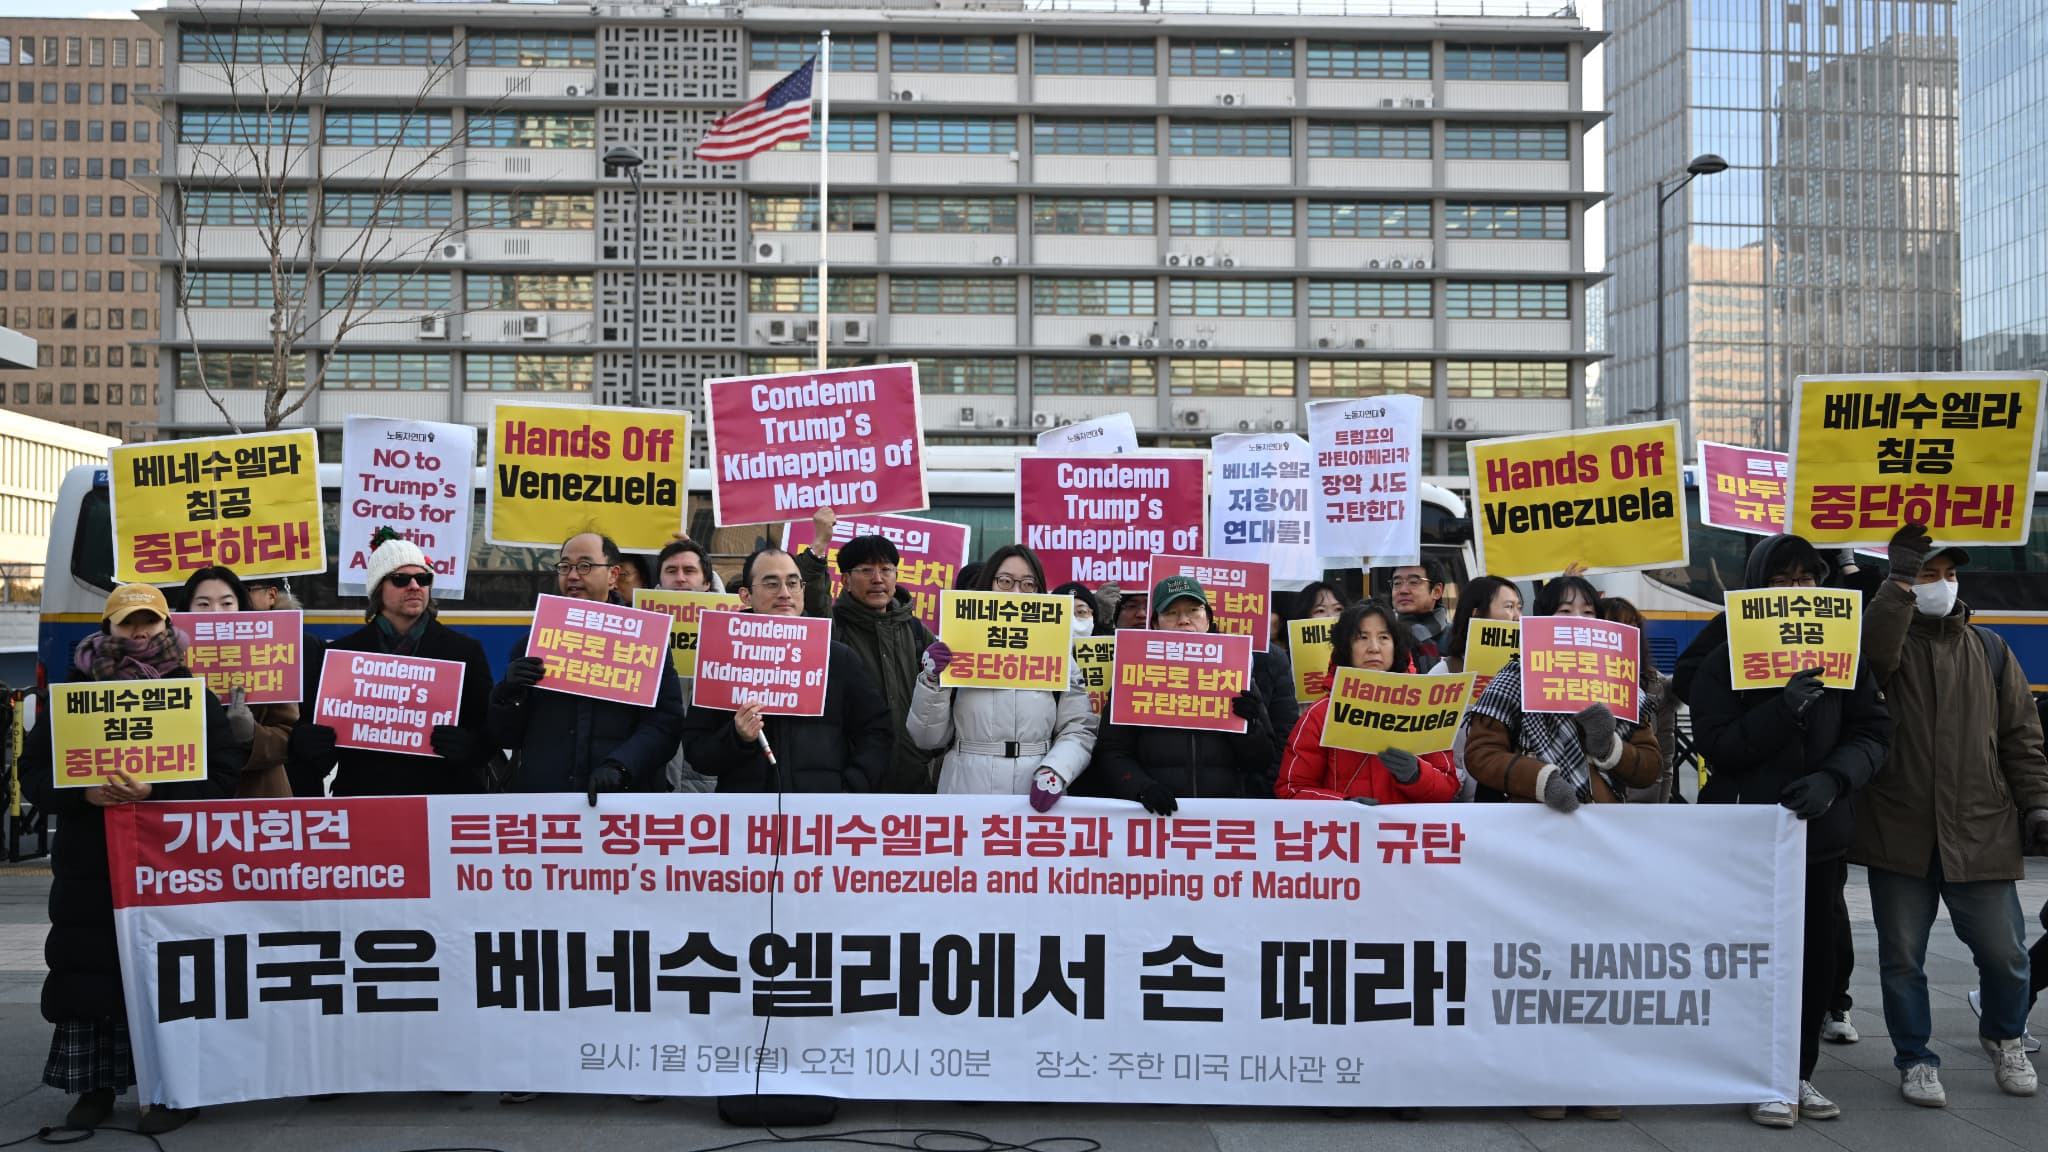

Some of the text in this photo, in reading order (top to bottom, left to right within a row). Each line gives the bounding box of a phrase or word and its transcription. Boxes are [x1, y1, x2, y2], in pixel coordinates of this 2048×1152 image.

[751, 378, 876, 412] Condemn
[1824, 391, 2022, 430] 베네수엘라
[504, 420, 675, 463] Hands Off
[761, 410, 871, 444] Trump's
[1335, 427, 1394, 446] 트럼프의
[133, 444, 301, 487] 베네수엘라
[373, 448, 441, 471] NO to
[724, 438, 913, 482] Kidnapping of
[1318, 447, 1410, 468] 라틴아메리카
[1486, 441, 1665, 493] Hands Off
[1876, 437, 1955, 476] 침공
[359, 473, 457, 501] Trump's
[498, 464, 677, 507] Venezuela
[1057, 462, 1170, 489] Condemn
[1321, 472, 1408, 496] 장악 시도
[1717, 473, 1787, 499] 마두
[186, 487, 252, 521] 침공
[774, 480, 877, 511] Maduro
[1063, 494, 1163, 523] Trump's
[1228, 487, 1308, 512] 저항에
[1809, 482, 2012, 530] 중단하라!
[352, 499, 456, 523] Grab for
[1326, 500, 1405, 523] 규탄한다
[1484, 486, 1674, 536] Venezuela
[134, 521, 310, 573] 중단하라!
[1028, 524, 1199, 554] Kidnapping of
[1223, 520, 1311, 545] 연대를!
[1072, 555, 1149, 583] Madur
[955, 597, 1064, 625] 베네수엘라
[1224, 591, 1264, 616] 납치
[1741, 595, 1852, 620] 베네수엘라
[195, 621, 273, 640] 트럼프의
[564, 607, 644, 638] 트럼프의
[728, 617, 807, 641] Condemn
[987, 625, 1029, 650] 침공
[1779, 622, 1824, 645] 침공
[537, 627, 608, 660] 마두로
[612, 638, 659, 669] 납치
[731, 640, 801, 664] Trump's
[1146, 640, 1223, 664] 트럼프의
[1553, 626, 1622, 652] 트럼프의
[250, 643, 295, 666] 납치
[351, 656, 436, 682] Condemn
[949, 651, 1061, 683] 중단하라!
[1530, 650, 1636, 683] 마두로 납치
[1743, 650, 1852, 680] 중단하라!
[543, 654, 643, 693] 규탄한다!
[702, 661, 823, 687] Kidnapping of
[1122, 664, 1242, 694] 마두로 납치
[66, 686, 193, 715] 베네수엘라
[353, 679, 428, 703] Trump's
[731, 686, 799, 709] Maduro
[1132, 691, 1229, 719] 규탄한다!
[1341, 676, 1421, 707] Hands
[1426, 680, 1465, 706] Off
[1542, 677, 1630, 708] 규탄한다!
[322, 698, 426, 727] Kidnapping
[1333, 702, 1458, 733] Venezuela
[103, 717, 153, 741] 침공
[352, 723, 424, 747] Maduro
[65, 744, 195, 777] 중단하라!
[163, 810, 350, 853] 기자회견
[450, 814, 1466, 863] 트럼프 정부의 베네수엘라 침공과 마두로 납치 규탄
[135, 861, 405, 895] Press Conference
[457, 863, 1361, 901] No to Trump's Invasion of Venezuela and kidnapping of Maduro
[157, 929, 1467, 1026] 미국은 베네수엘라에서 손 떼라!
[1493, 942, 1770, 983] US, HANDS OFF
[1491, 988, 1711, 1027] VENEZUELA!
[580, 1042, 991, 1077] 일시: 1월 5일(월) 오전 10시 30분
[1036, 1050, 1365, 1085] 장소: 주한 미국 대사관 앞
